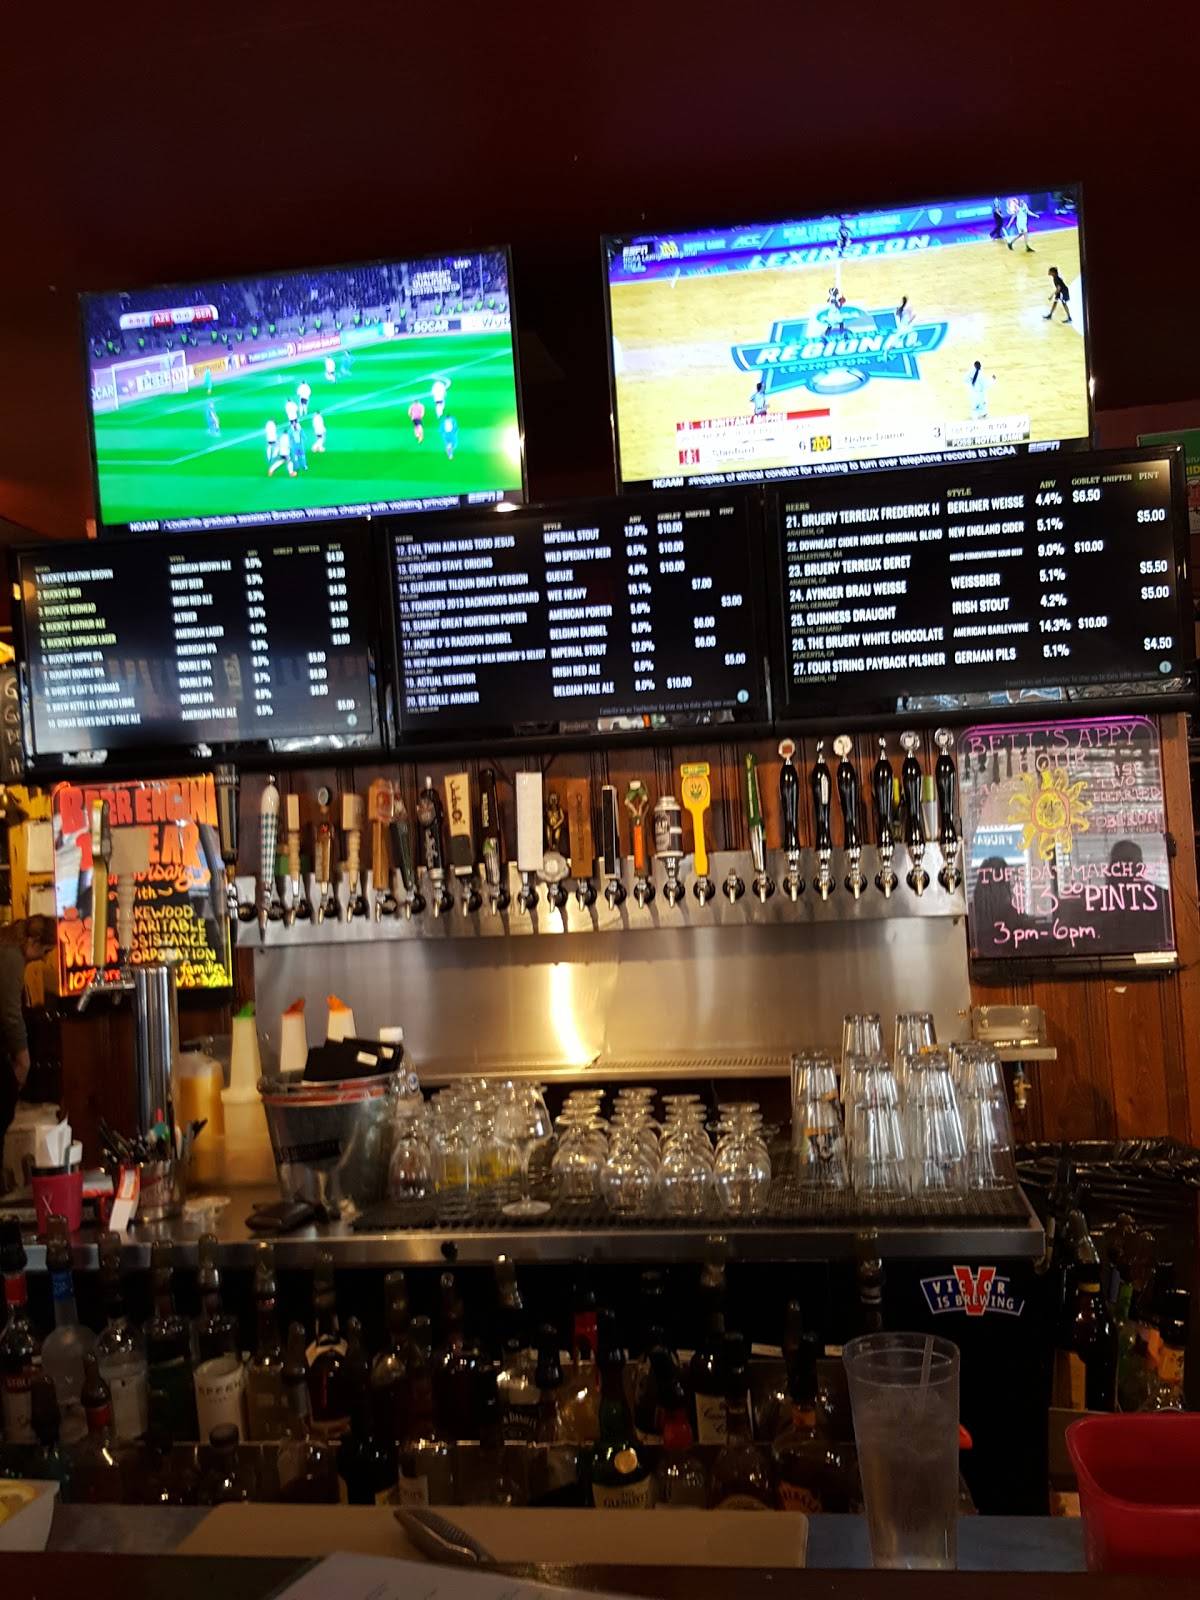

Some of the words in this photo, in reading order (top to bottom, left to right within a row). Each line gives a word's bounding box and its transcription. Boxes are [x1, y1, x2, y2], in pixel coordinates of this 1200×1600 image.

[1028, 440, 1061, 453] ESPN
[736, 470, 764, 482] ethical
[765, 467, 799, 479] conduct
[800, 465, 813, 474] for
[813, 463, 848, 476] refusing
[849, 461, 858, 470] to
[860, 459, 877, 469] turn
[878, 457, 898, 468] over
[899, 453, 942, 467] telephone
[943, 449, 977, 461] records
[978, 448, 987, 458] to
[989, 445, 1016, 456] NCAA
[1138, 471, 1159, 481] PINT
[947, 487, 972, 498] STYLE
[1039, 480, 1057, 489] ABV
[947, 498, 989, 515] BERLINER
[991, 495, 1024, 511] WEISSE
[1035, 491, 1062, 507] 4.4%
[801, 511, 839, 528] BRUERY
[839, 507, 880, 524] TERREUX
[880, 503, 931, 521] FREDERICK
[931, 502, 940, 516] H
[1137, 508, 1165, 523] $5.00
[948, 527, 965, 539] NEW
[966, 523, 1001, 537] ENGLAND
[1001, 521, 1024, 534] CIDER
[799, 537, 837, 551] DOWNEAST
[838, 536, 859, 548] CIDER
[860, 533, 884, 546] HOUSE
[885, 531, 918, 544] ORIGINAL
[919, 528, 943, 541] BLEND
[1074, 540, 1104, 554] $10.00
[1037, 543, 1065, 557] 9.0%
[804, 560, 841, 577] BRUERY
[842, 558, 881, 574] TERREUX
[883, 554, 912, 569] BERET
[1139, 560, 1168, 574] $5.50
[950, 572, 1001, 590] WEISSBIER
[805, 585, 844, 602] AYINGER
[845, 582, 872, 599] BRAU
[873, 580, 907, 596] WEISSE
[1141, 586, 1170, 600] $5.00
[952, 599, 978, 615] IRISH
[979, 597, 1010, 613] STOUT
[1040, 594, 1067, 608] 4.2%
[548, 607, 585, 621] AMERICAN
[585, 604, 613, 618] PORTER
[806, 609, 851, 626] GUINNESS
[852, 606, 897, 622] DRAUGHT
[953, 626, 987, 638] AMERICAN
[987, 622, 1029, 636] BARLEYWINE
[1039, 618, 1072, 633] 14.3%
[1078, 616, 1108, 630] $10.00
[807, 635, 824, 650] THE
[825, 633, 861, 648] BRUERY
[862, 630, 890, 646] WHITE
[891, 627, 944, 644] CHOCOLATE
[1143, 636, 1172, 651] $4.50
[807, 660, 832, 675] FOUR
[832, 657, 865, 673] STRING
[866, 654, 908, 671] PAYBACK
[908, 652, 946, 668] PILSNER
[954, 649, 994, 665] GERMAN
[995, 647, 1017, 661] PILS
[588, 663, 601, 676] ALE
[601, 681, 615, 694] ALE
[148, 823, 202, 868] EAR
[1071, 861, 1134, 881] MARCH
[1085, 883, 1158, 911] PINTS
[937, 1295, 950, 1308] IS
[955, 1294, 1014, 1310] BREWING
